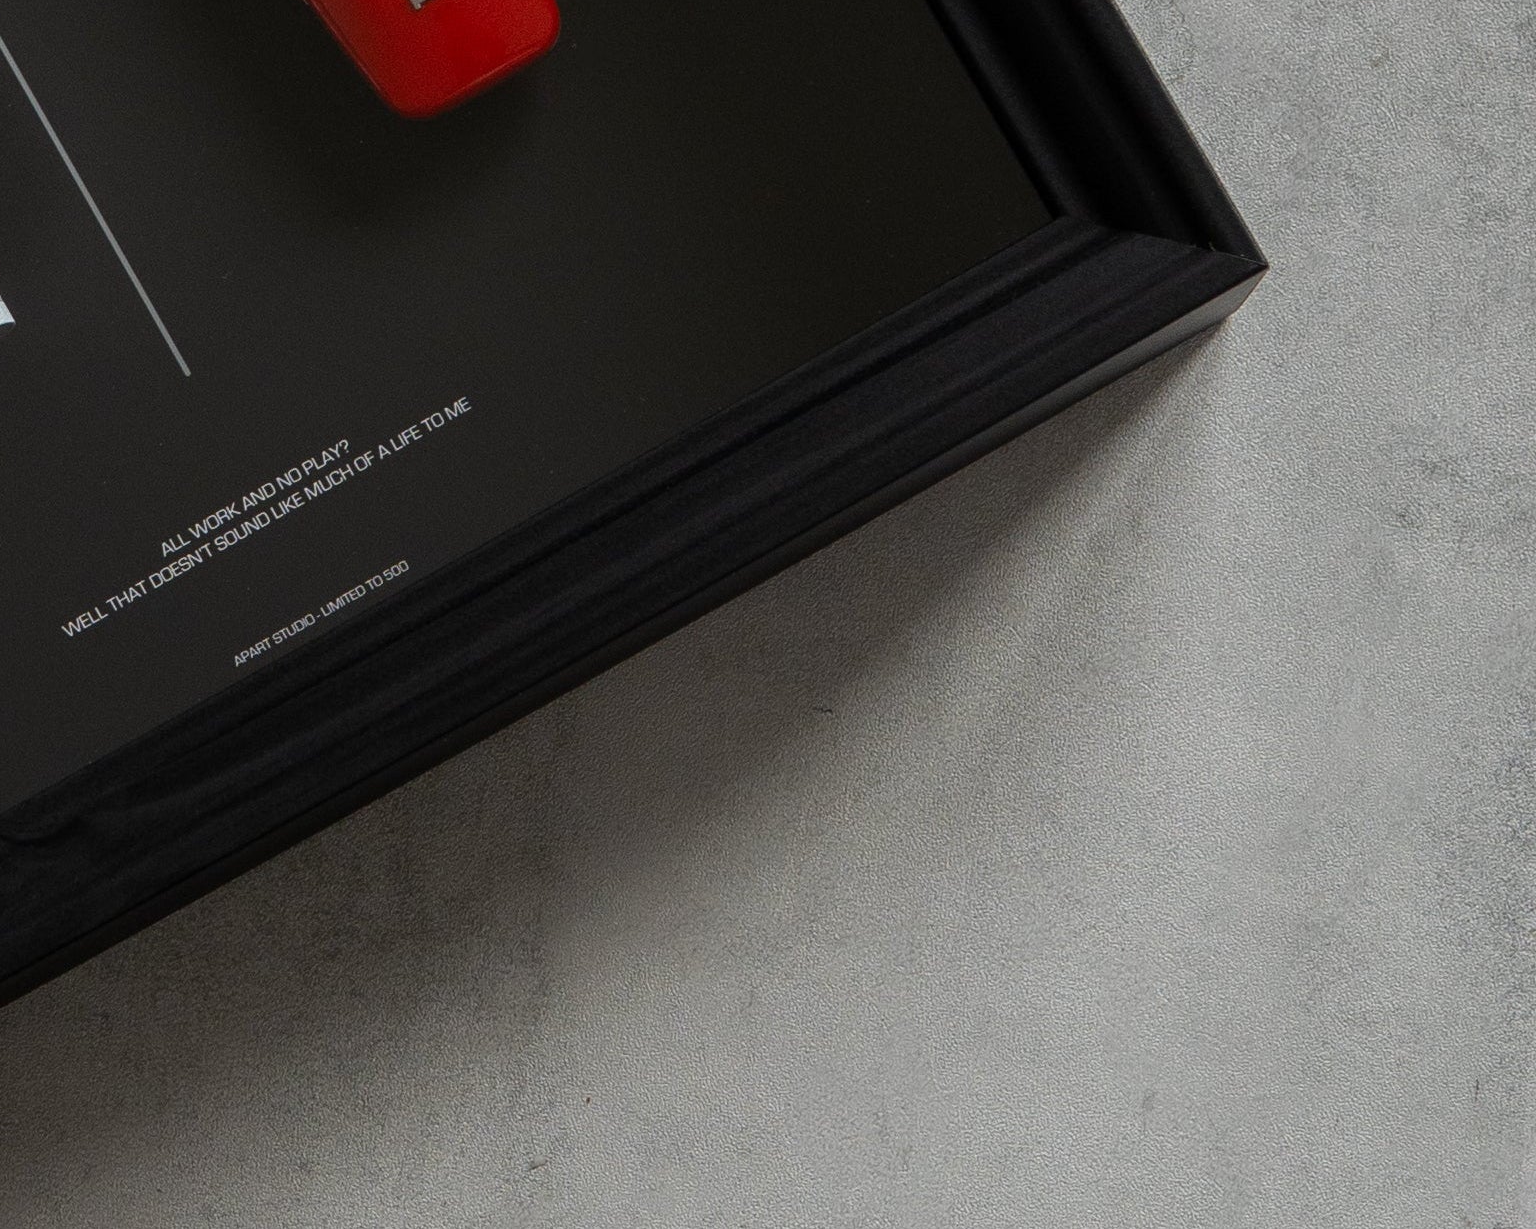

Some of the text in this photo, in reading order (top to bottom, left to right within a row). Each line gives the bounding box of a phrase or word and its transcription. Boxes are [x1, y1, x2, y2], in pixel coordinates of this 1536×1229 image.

[60, 396, 472, 638] WELL THAT DOESN'T SOUND LIKE MUCH OF A LIFE TO ME
[161, 438, 350, 558] ALL WORK AND NO PLAY?
[233, 636, 272, 668] APART
[271, 613, 317, 645] STUDIO
[319, 584, 367, 618] LIMITED
[364, 574, 384, 590] TO
[382, 559, 410, 582] 500
